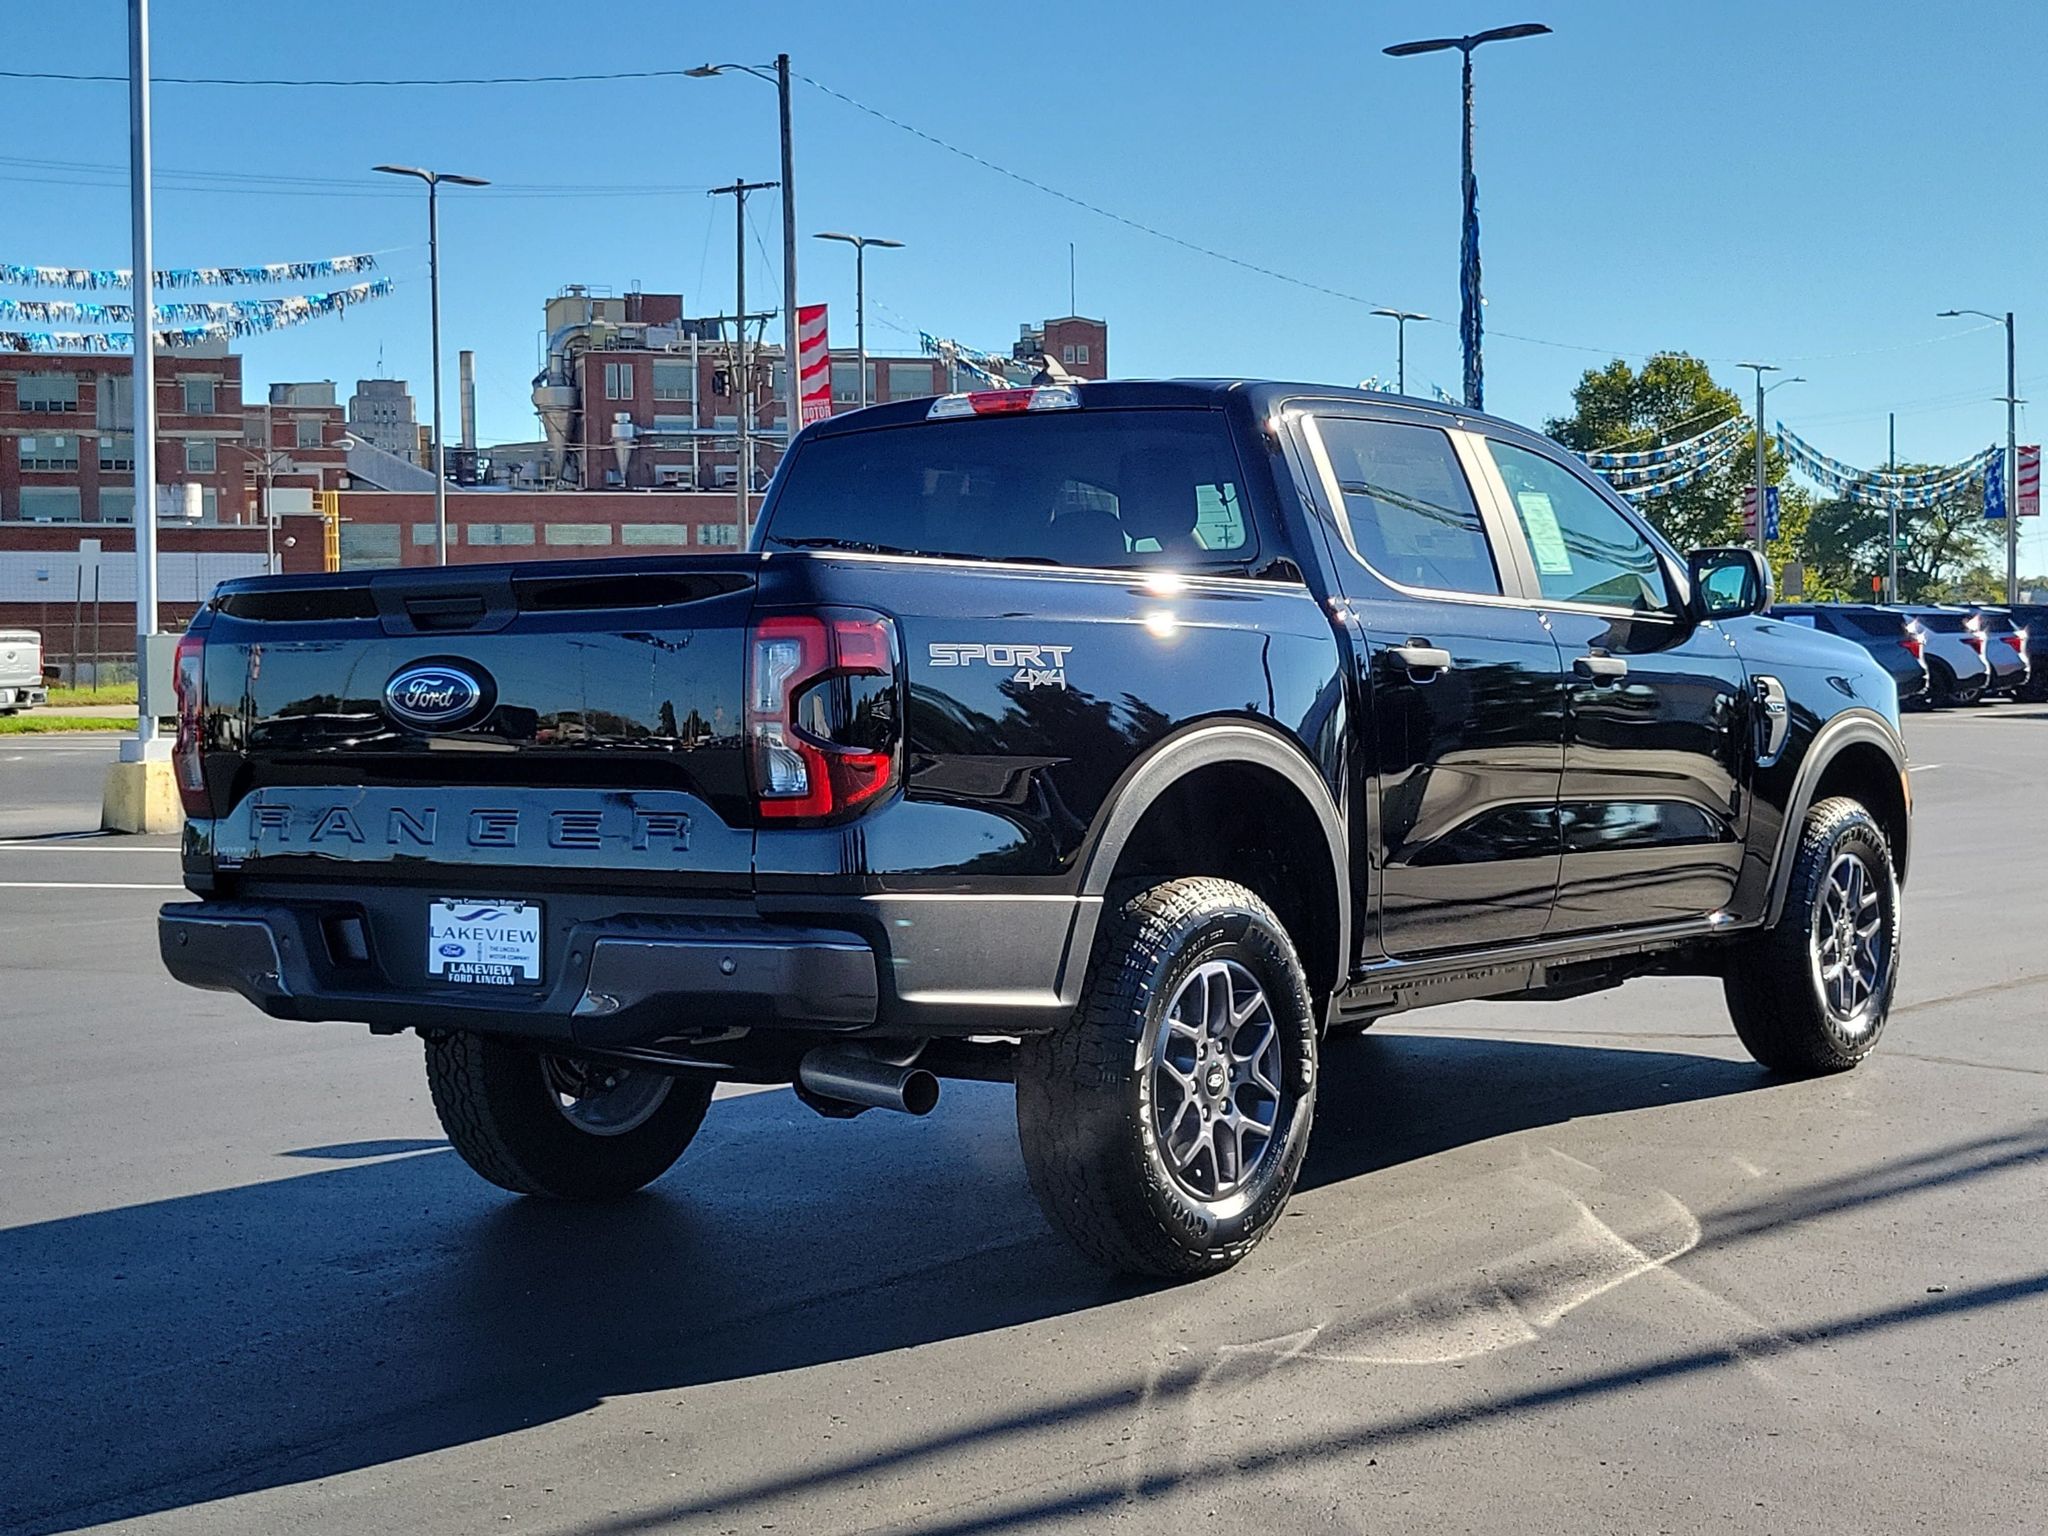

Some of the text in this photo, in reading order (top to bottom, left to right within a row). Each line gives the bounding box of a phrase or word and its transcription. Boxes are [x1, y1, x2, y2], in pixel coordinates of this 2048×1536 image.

[929, 643, 1073, 667] SPORT
[405, 678, 456, 708] Ford
[249, 804, 690, 851] RANGER
[430, 925, 538, 943] LAKEVIEW
[448, 973, 515, 986] FORD LINCOLN
[450, 963, 513, 976] LAKEVIEW
